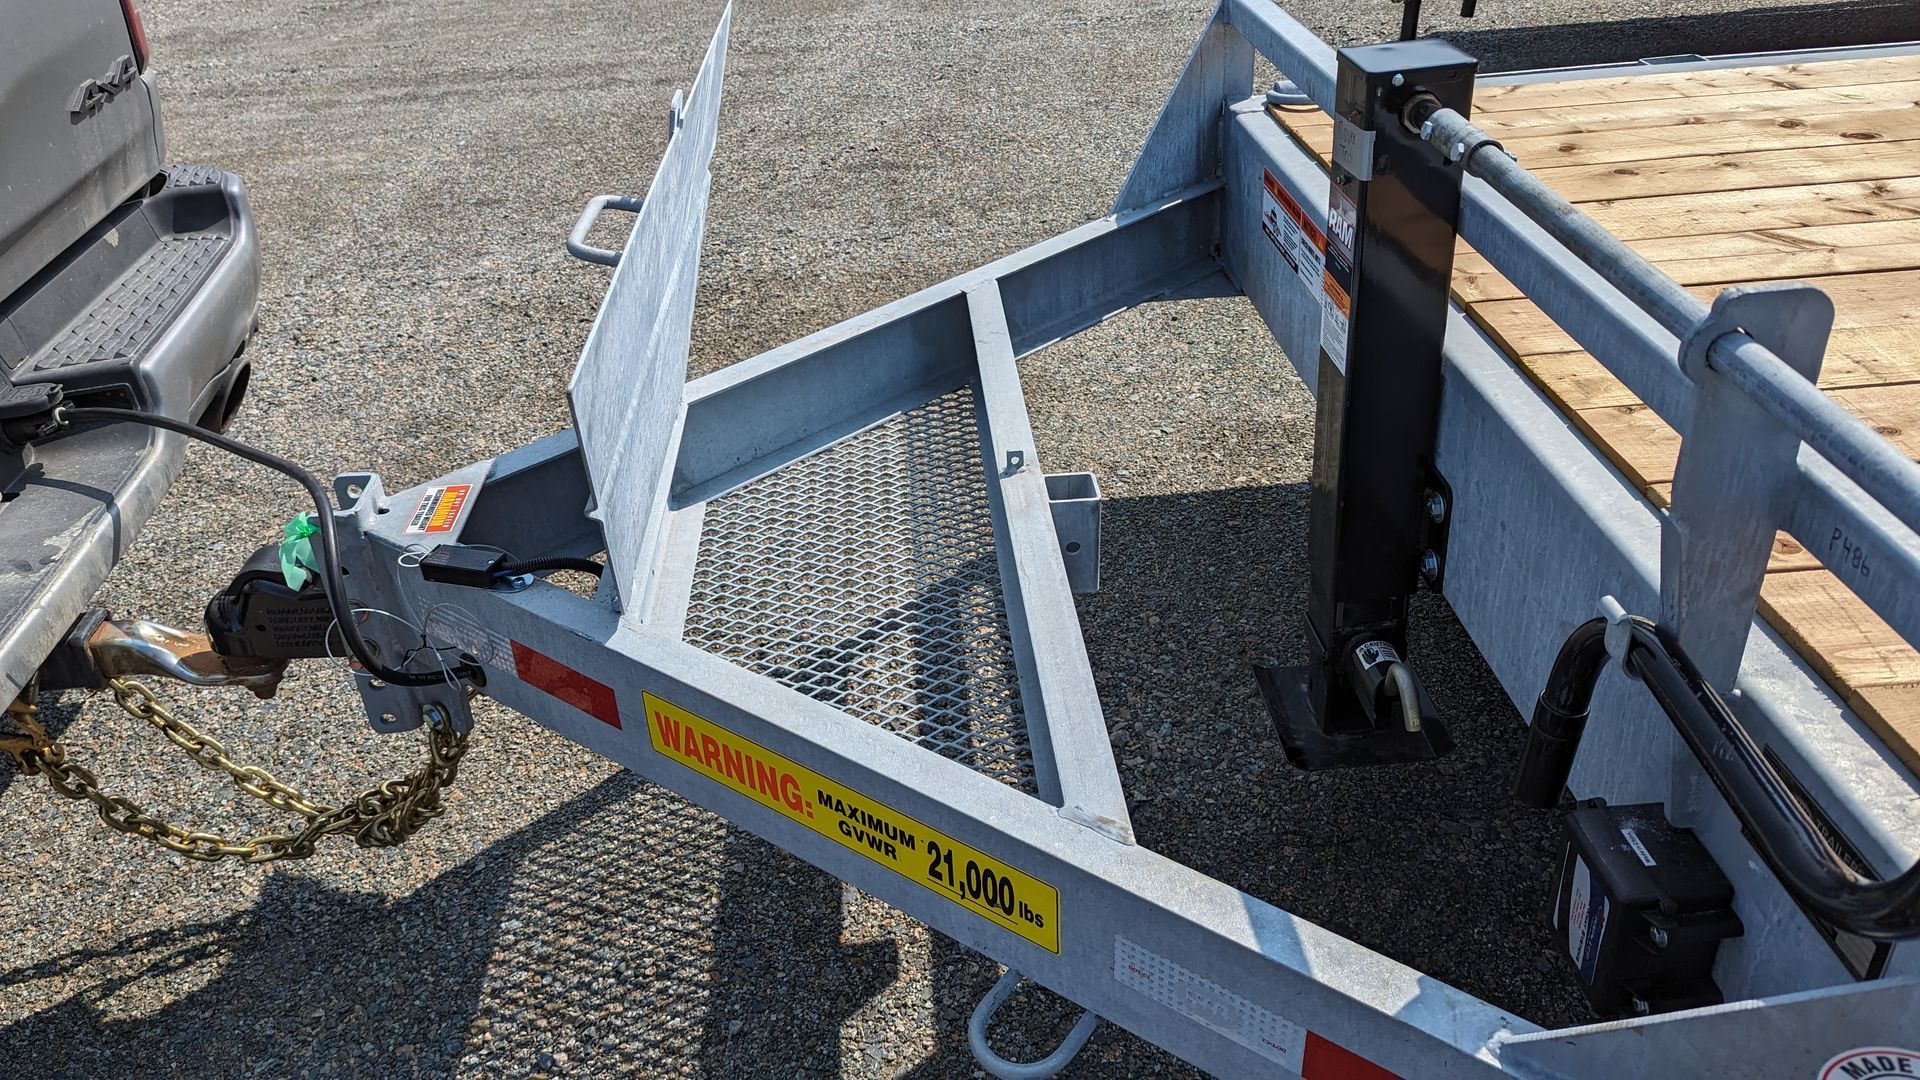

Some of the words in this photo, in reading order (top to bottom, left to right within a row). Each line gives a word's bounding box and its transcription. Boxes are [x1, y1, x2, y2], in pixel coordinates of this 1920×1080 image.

[1328, 207, 1354, 250] RAM
[1829, 527, 1870, 577] P486
[654, 710, 814, 819] WARNING:
[817, 789, 916, 851] MAXIMUM
[838, 820, 897, 861] GVWR
[927, 840, 1014, 916] 21,000
[1018, 900, 1044, 928] lbs
[1839, 1055, 1914, 1080] MADE
